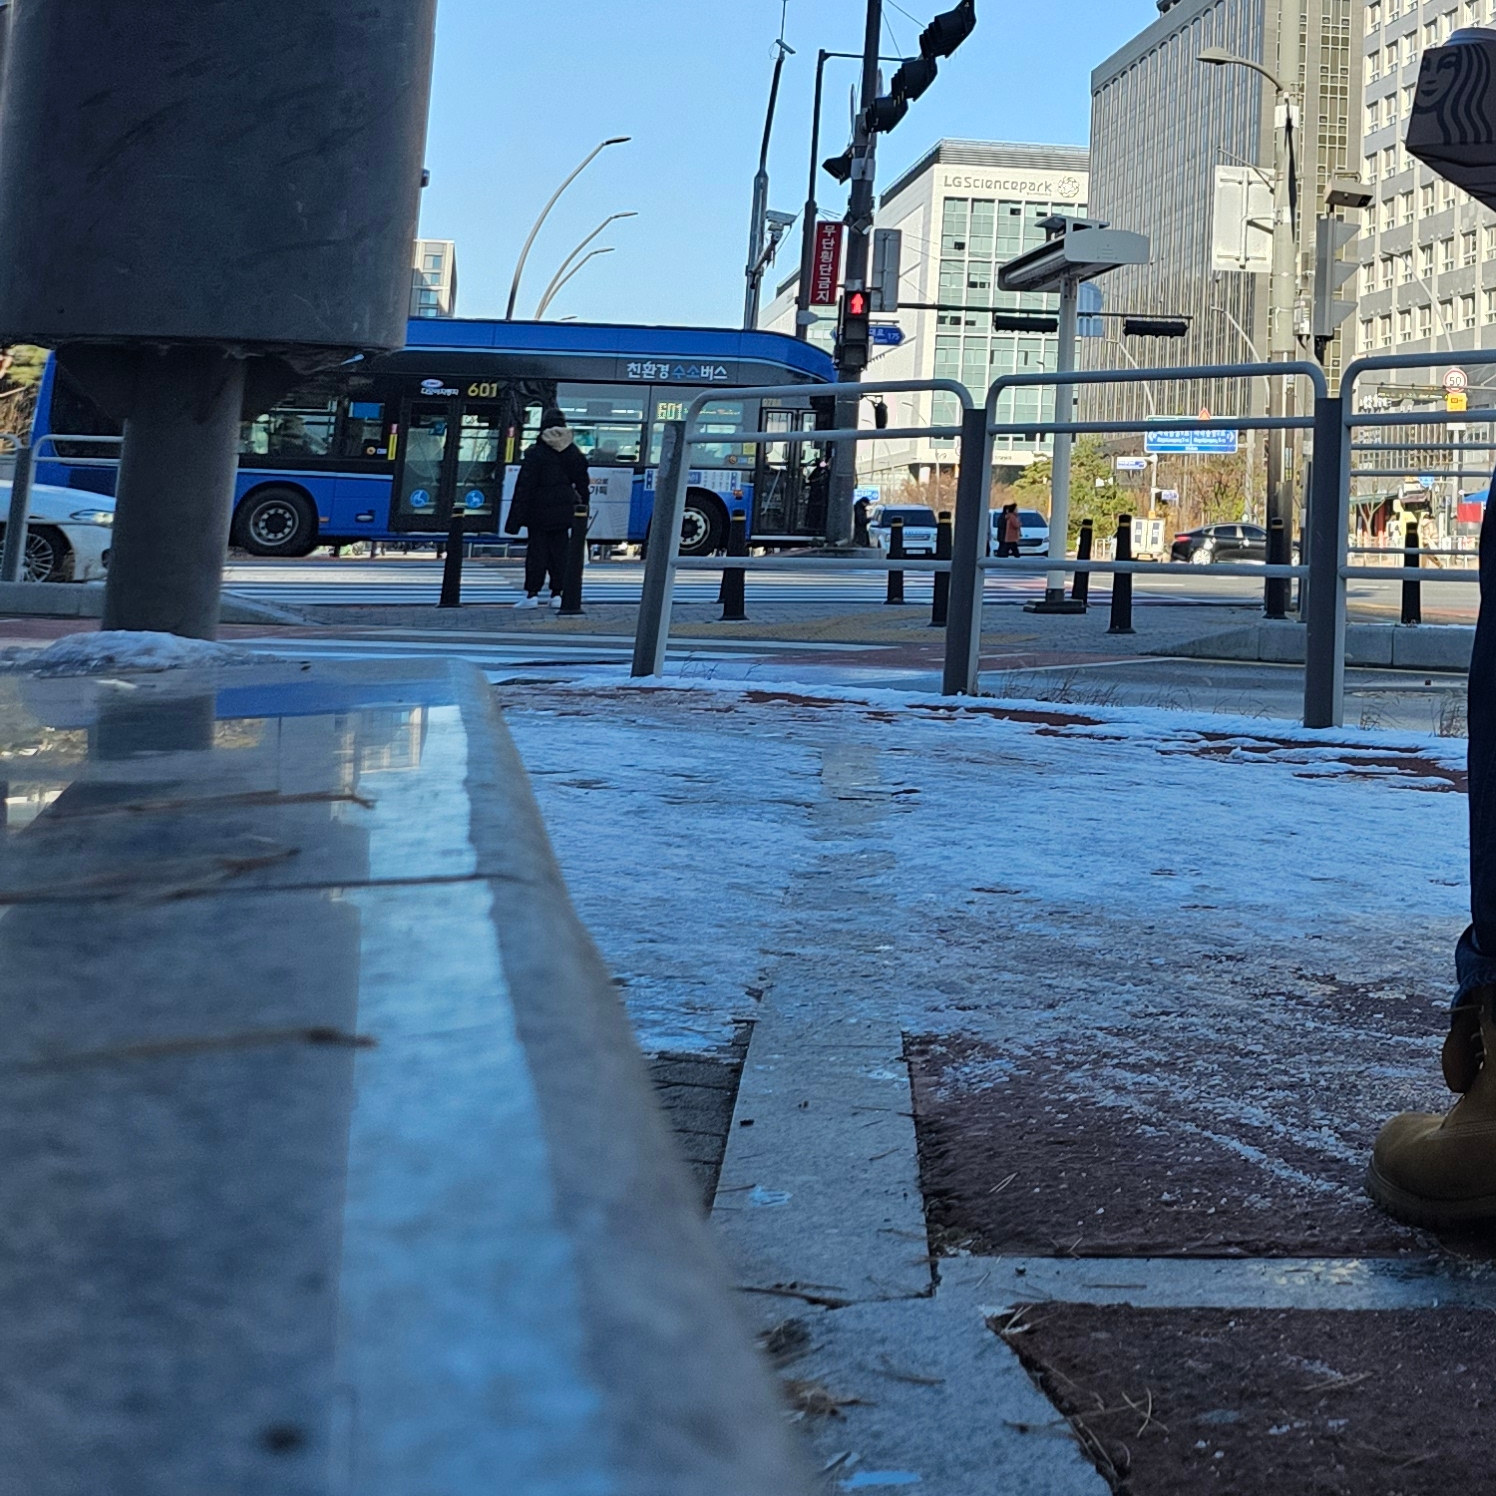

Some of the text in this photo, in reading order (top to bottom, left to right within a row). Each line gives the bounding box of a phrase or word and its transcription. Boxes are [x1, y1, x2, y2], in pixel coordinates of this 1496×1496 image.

[815, 225, 837, 303] 무단횡단금지
[887, 332, 900, 341] 175
[626, 360, 728, 381] 친환경 수소버스
[1449, 376, 1463, 386] 50
[467, 382, 499, 398] 601
[656, 402, 684, 421] 601
